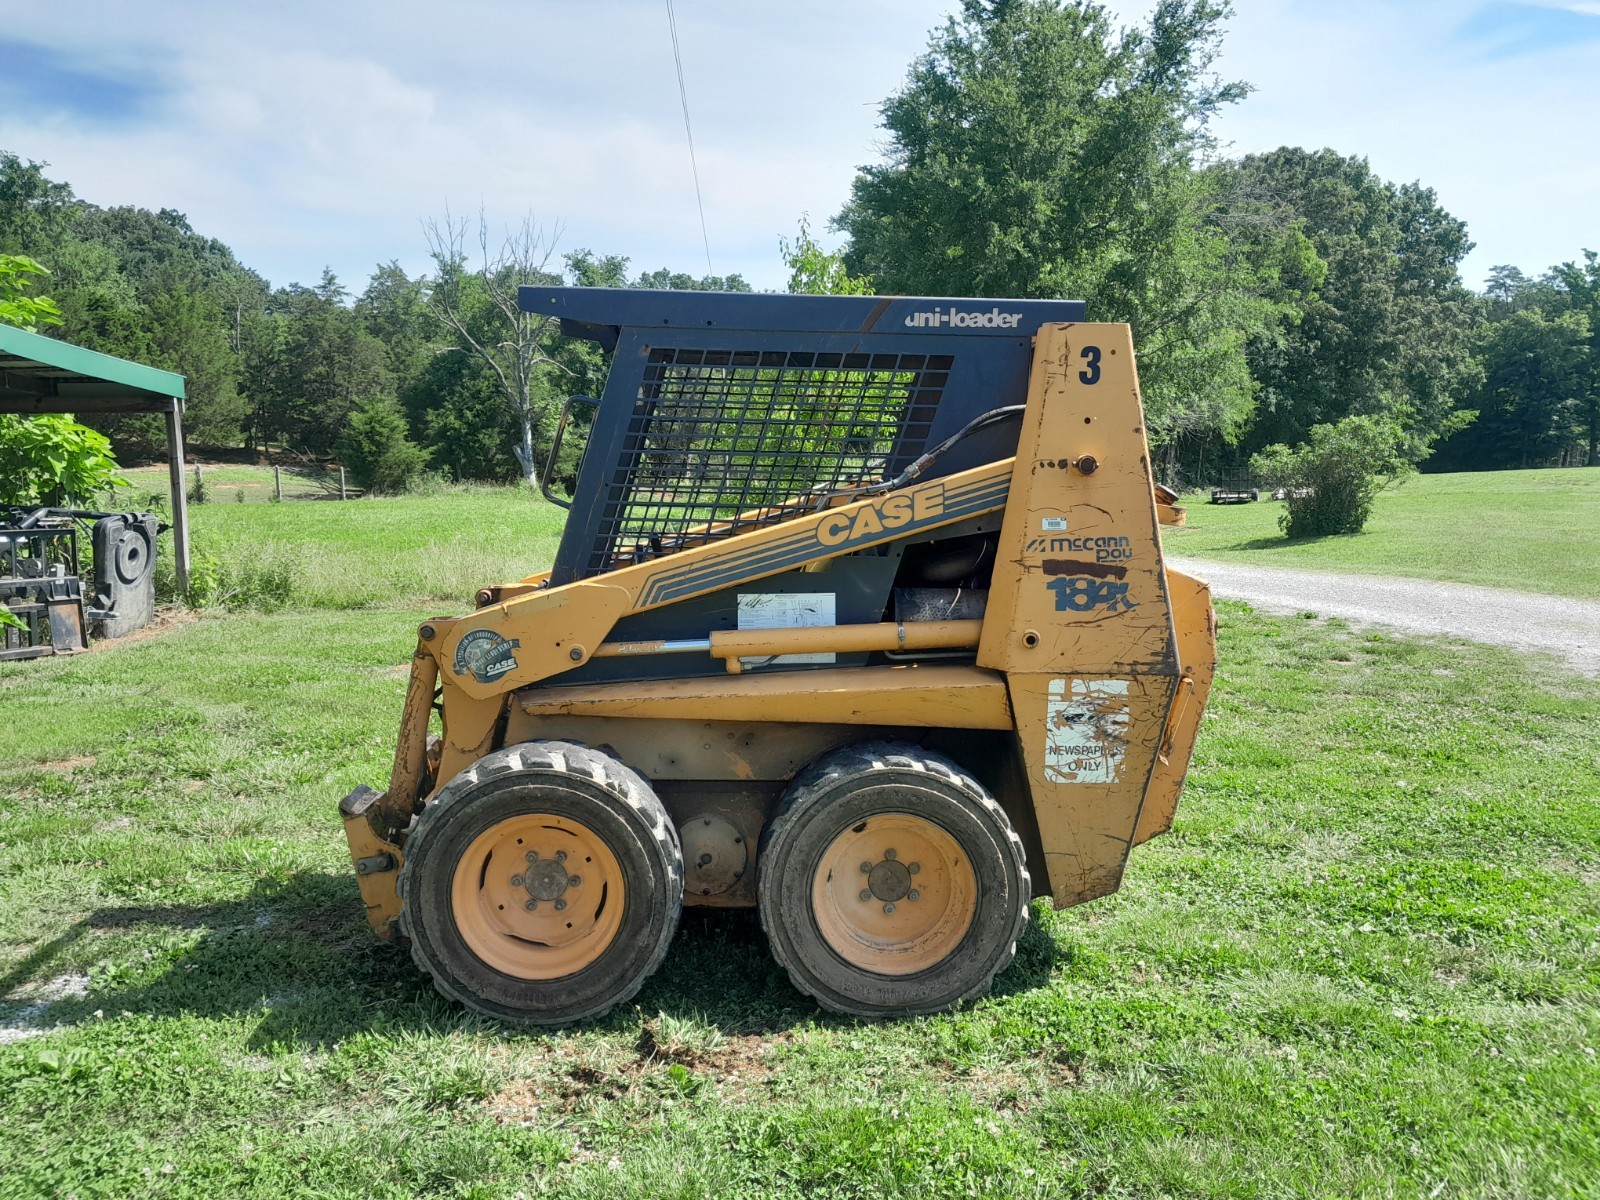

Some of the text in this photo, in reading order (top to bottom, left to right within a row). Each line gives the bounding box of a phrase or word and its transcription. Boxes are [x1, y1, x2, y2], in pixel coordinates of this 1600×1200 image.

[905, 307, 1023, 328] uni-loader
[1078, 345, 1102, 385] 3
[816, 482, 945, 547] CASE
[486, 657, 515, 672] CASE
